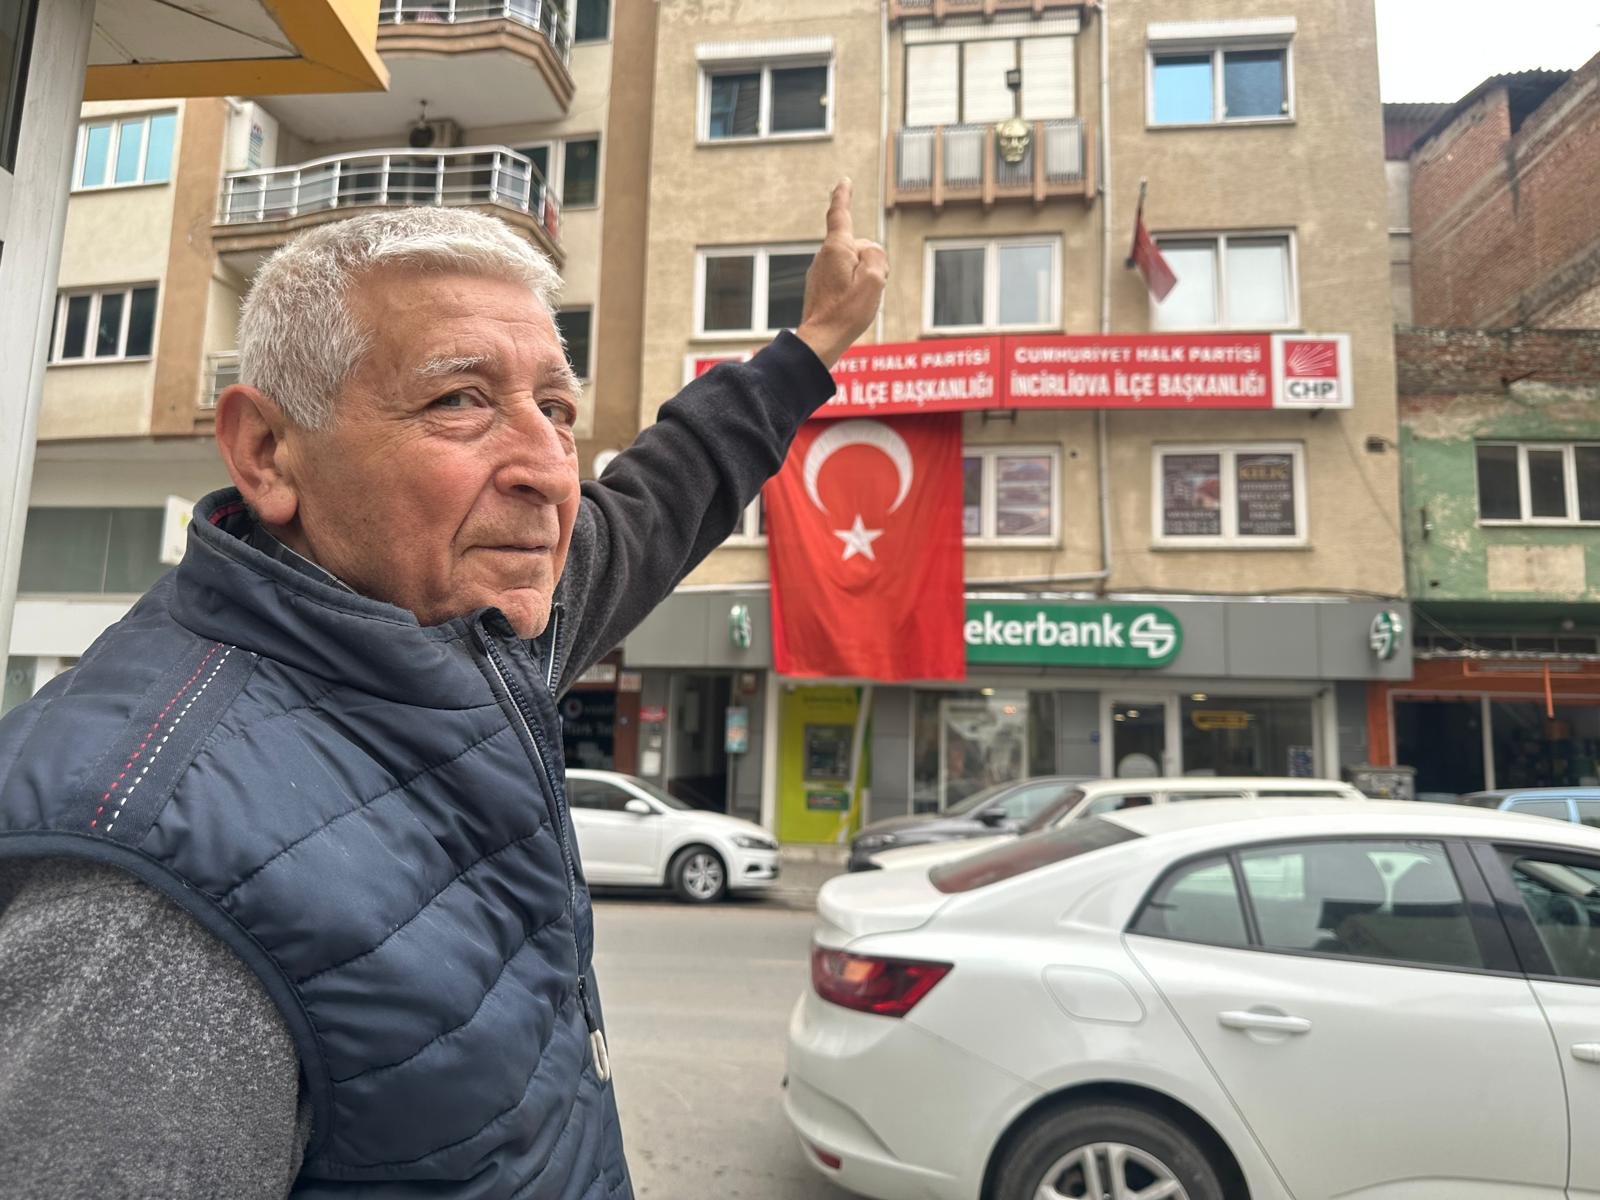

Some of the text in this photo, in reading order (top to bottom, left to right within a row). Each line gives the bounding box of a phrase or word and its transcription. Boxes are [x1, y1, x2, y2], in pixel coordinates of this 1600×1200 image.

[871, 354, 917, 372] HALK
[921, 346, 991, 368] PARTİSİ
[1014, 343, 1261, 363] CUMHURİYET HALK PARTİSİ
[851, 379, 889, 409] İLÇE
[891, 372, 994, 407] BAŞKANLIĞI
[1010, 369, 1266, 402] İNCİRLİOVA İLÇE BAŞKANLIĞI
[1288, 381, 1334, 397] CHP
[963, 610, 1124, 647] ekerbank
